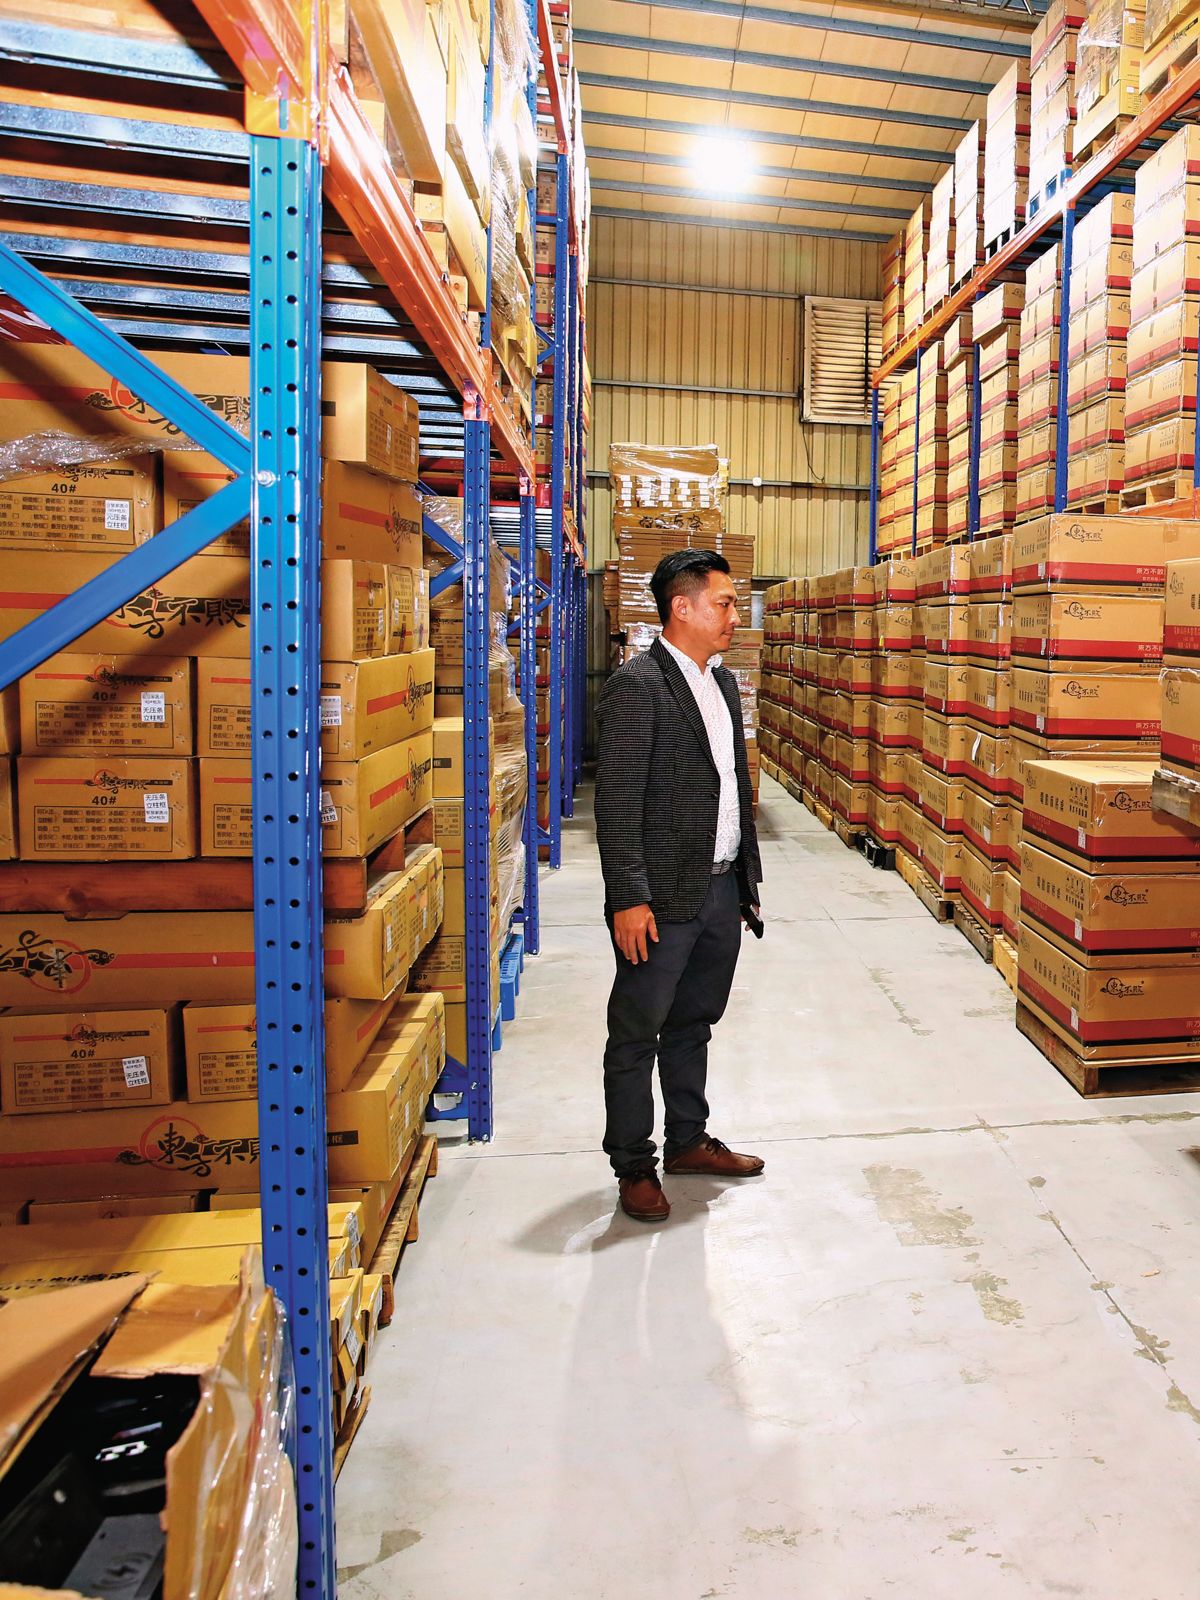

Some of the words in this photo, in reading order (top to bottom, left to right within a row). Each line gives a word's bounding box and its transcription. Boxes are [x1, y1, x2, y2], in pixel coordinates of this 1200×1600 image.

[51, 483, 77, 493] 40#
[92, 691, 117, 701] 40#
[91, 795, 117, 806] 40#
[70, 1049, 96, 1059] 40#
